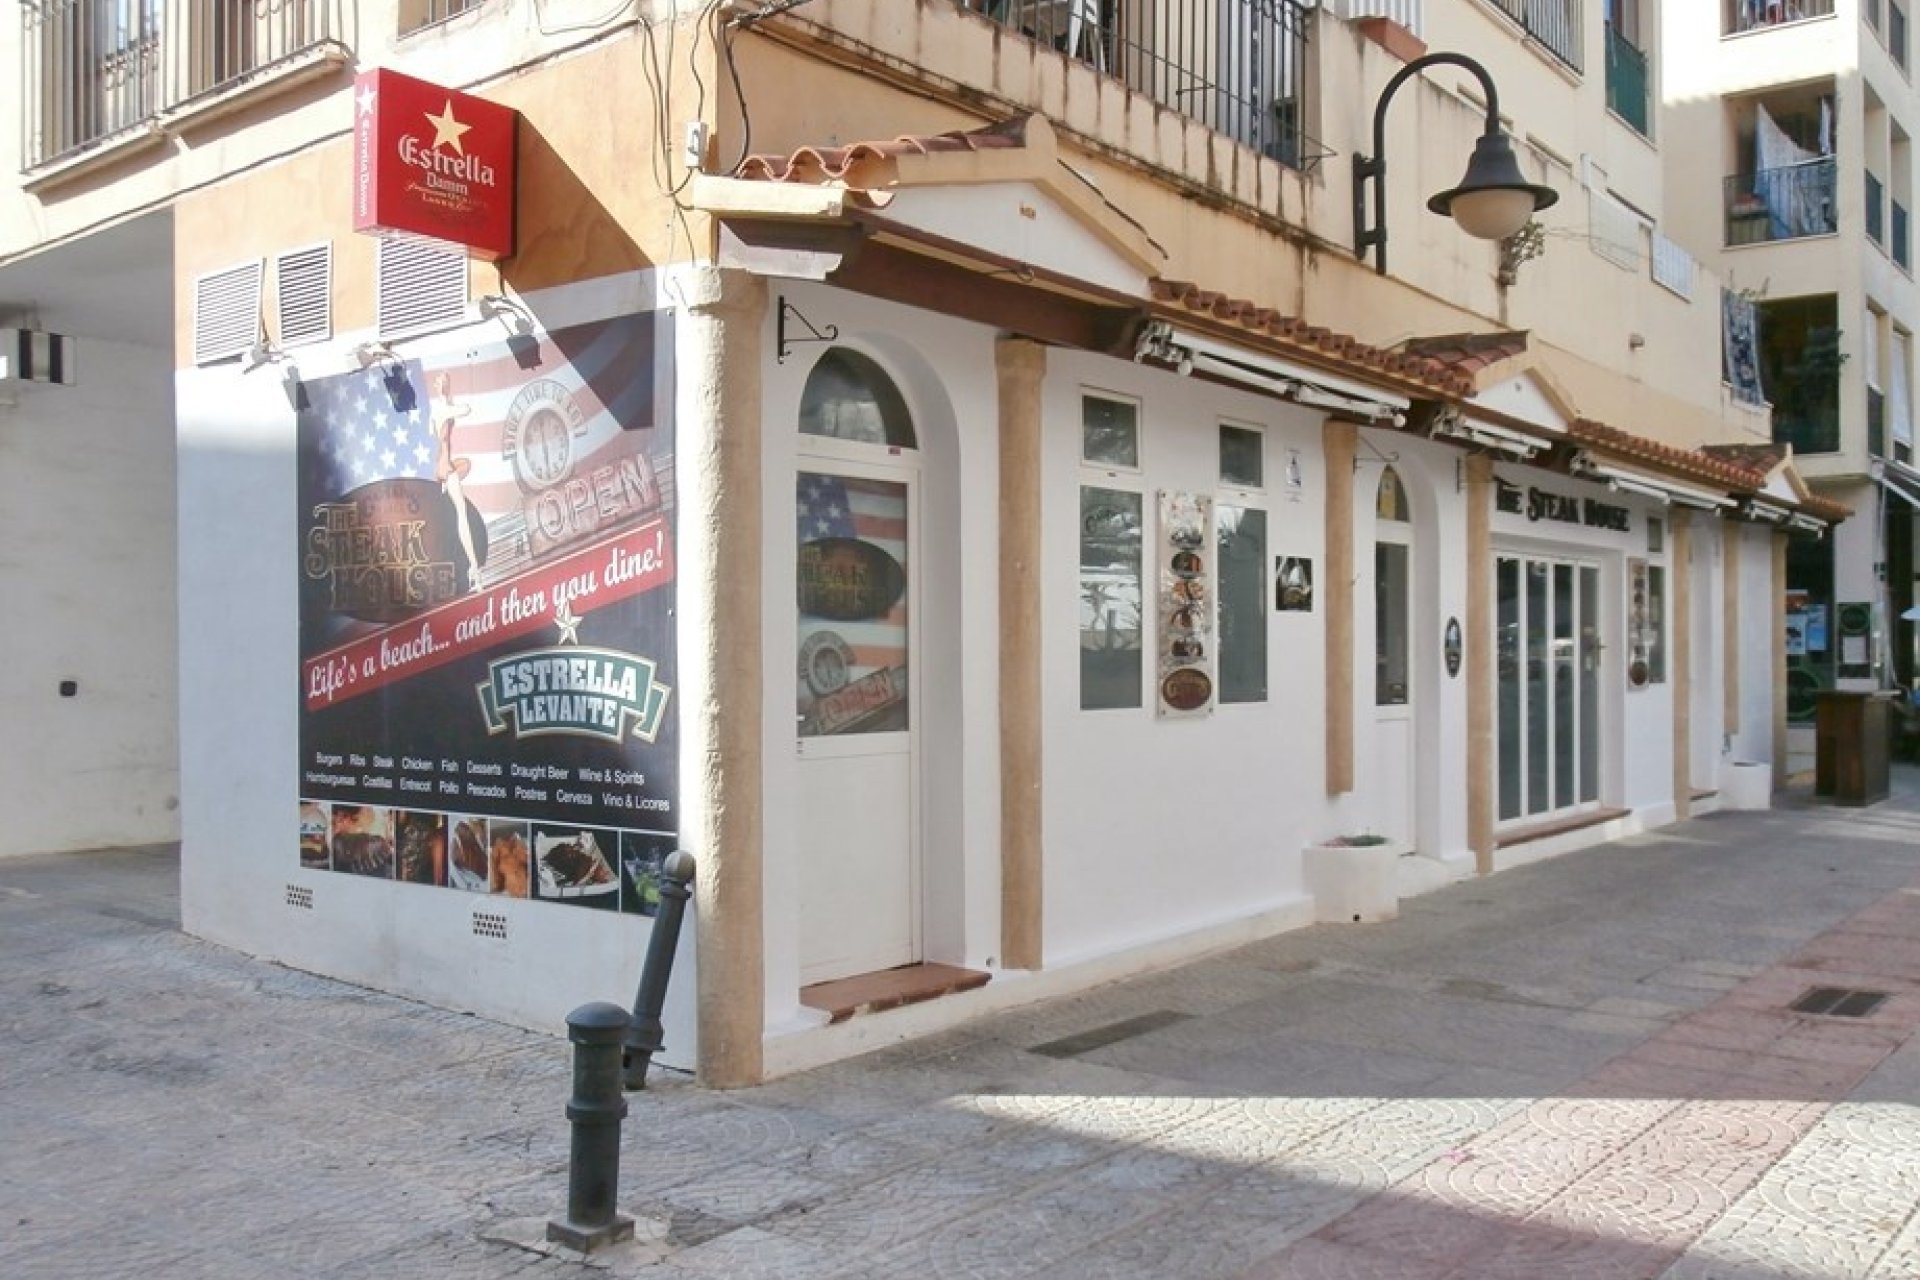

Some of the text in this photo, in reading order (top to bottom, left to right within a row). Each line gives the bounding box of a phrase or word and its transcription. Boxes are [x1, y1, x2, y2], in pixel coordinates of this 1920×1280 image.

[398, 134, 495, 187] Estrella
[426, 172, 468, 196] Damm
[313, 501, 358, 531] THE
[537, 453, 650, 540] OPEN
[304, 519, 431, 580] STEAK
[330, 561, 456, 609] HOUSE
[308, 656, 358, 701] Life's
[362, 655, 376, 678] a
[455, 597, 496, 644] and
[501, 586, 547, 626] then
[552, 570, 599, 618] you
[603, 530, 665, 587] dine!
[500, 657, 637, 702] ESTRELLA
[520, 694, 618, 728] LEVANTE
[401, 755, 435, 771] Chicken
[441, 758, 459, 772] Fish
[466, 760, 503, 776] Desserts
[510, 762, 546, 782] Draught
[547, 765, 570, 780] Beer
[578, 767, 603, 782] Wine
[604, 767, 612, 783] &
[614, 769, 645, 787] Spirits
[439, 780, 460, 796] Pollo
[467, 783, 507, 799] Pescados
[514, 785, 548, 801] Postres
[556, 788, 593, 805] Cerveza
[602, 792, 624, 808] Vino
[625, 793, 633, 809] &
[635, 795, 670, 812] Licores
